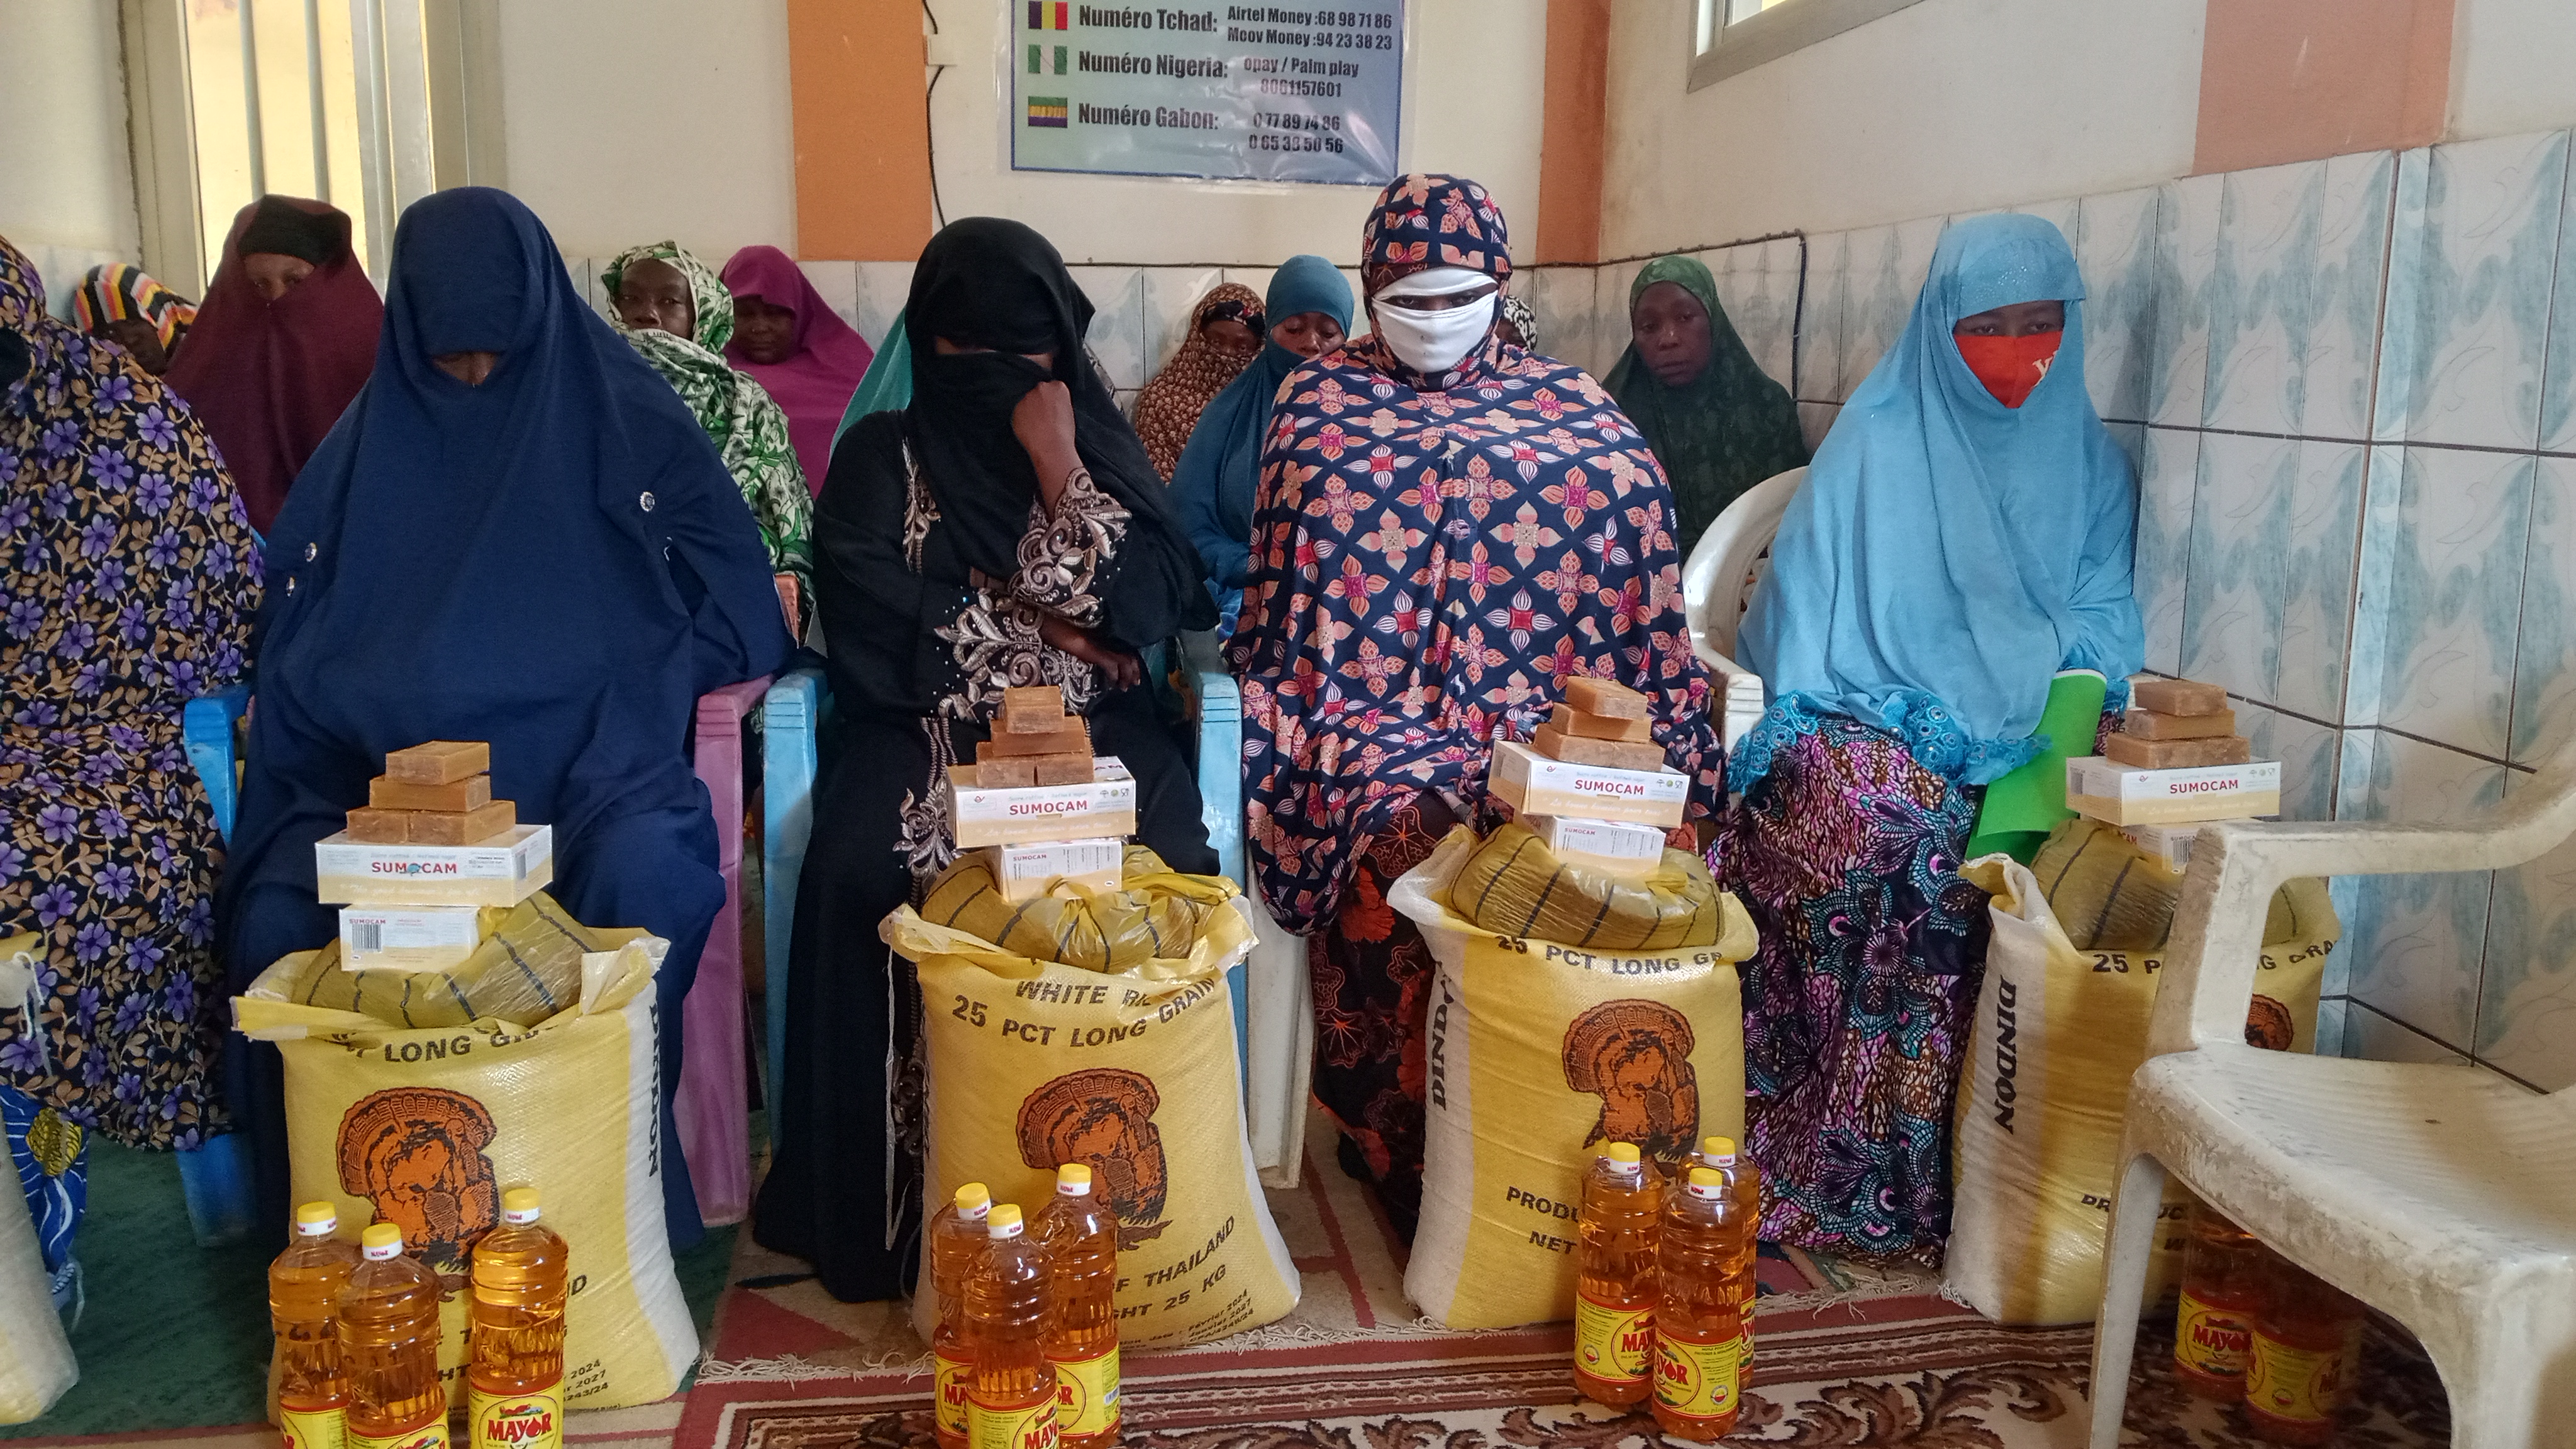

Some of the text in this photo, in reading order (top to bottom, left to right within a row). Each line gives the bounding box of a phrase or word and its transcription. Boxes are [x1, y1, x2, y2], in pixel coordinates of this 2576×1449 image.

[1079, 4, 1218, 32] Numéro Tchad:
[1228, 6, 1265, 23] Airtel
[1267, 8, 1312, 26] Money
[1338, 12, 1356, 28] 98
[1358, 13, 1372, 28] 71
[1374, 13, 1392, 29] 86
[1266, 29, 1311, 47] Money
[1336, 33, 1353, 48] 23
[1375, 35, 1392, 50] 23
[1079, 51, 1228, 79] Numéro Nigeria:
[1329, 60, 1359, 78] play
[1079, 103, 1219, 130] Numéro Gabon:
[1282, 113, 1301, 130] 89
[1325, 137, 1343, 153] 56
[1574, 779, 1645, 796] SUMOCAM
[2170, 779, 2238, 794] SUMOCAM
[1009, 800, 1088, 815] SUMOCAM
[1564, 827, 1596, 835] SUMOCAM
[1546, 945, 1597, 970] PCT
[1612, 957, 1680, 975] LONG
[2092, 953, 2129, 974] 25
[1014, 980, 1109, 1005] WHITE
[952, 977, 1215, 1048] 25 PCT LONG GRAIN
[384, 1035, 471, 1062] LONG
[1994, 974, 2017, 1135] DINDON
[1506, 1185, 1579, 1223] PROD
[1143, 1216, 1235, 1287] THAILAND
[1529, 1231, 1577, 1255] NET
[1163, 1290, 1191, 1311] 25
[1202, 1264, 1226, 1293] KG
[570, 1358, 601, 1379] 2024
[576, 1368, 606, 1389] 2027
[564, 1382, 609, 1402] 243/24
[486, 1412, 552, 1443] MAYOR
